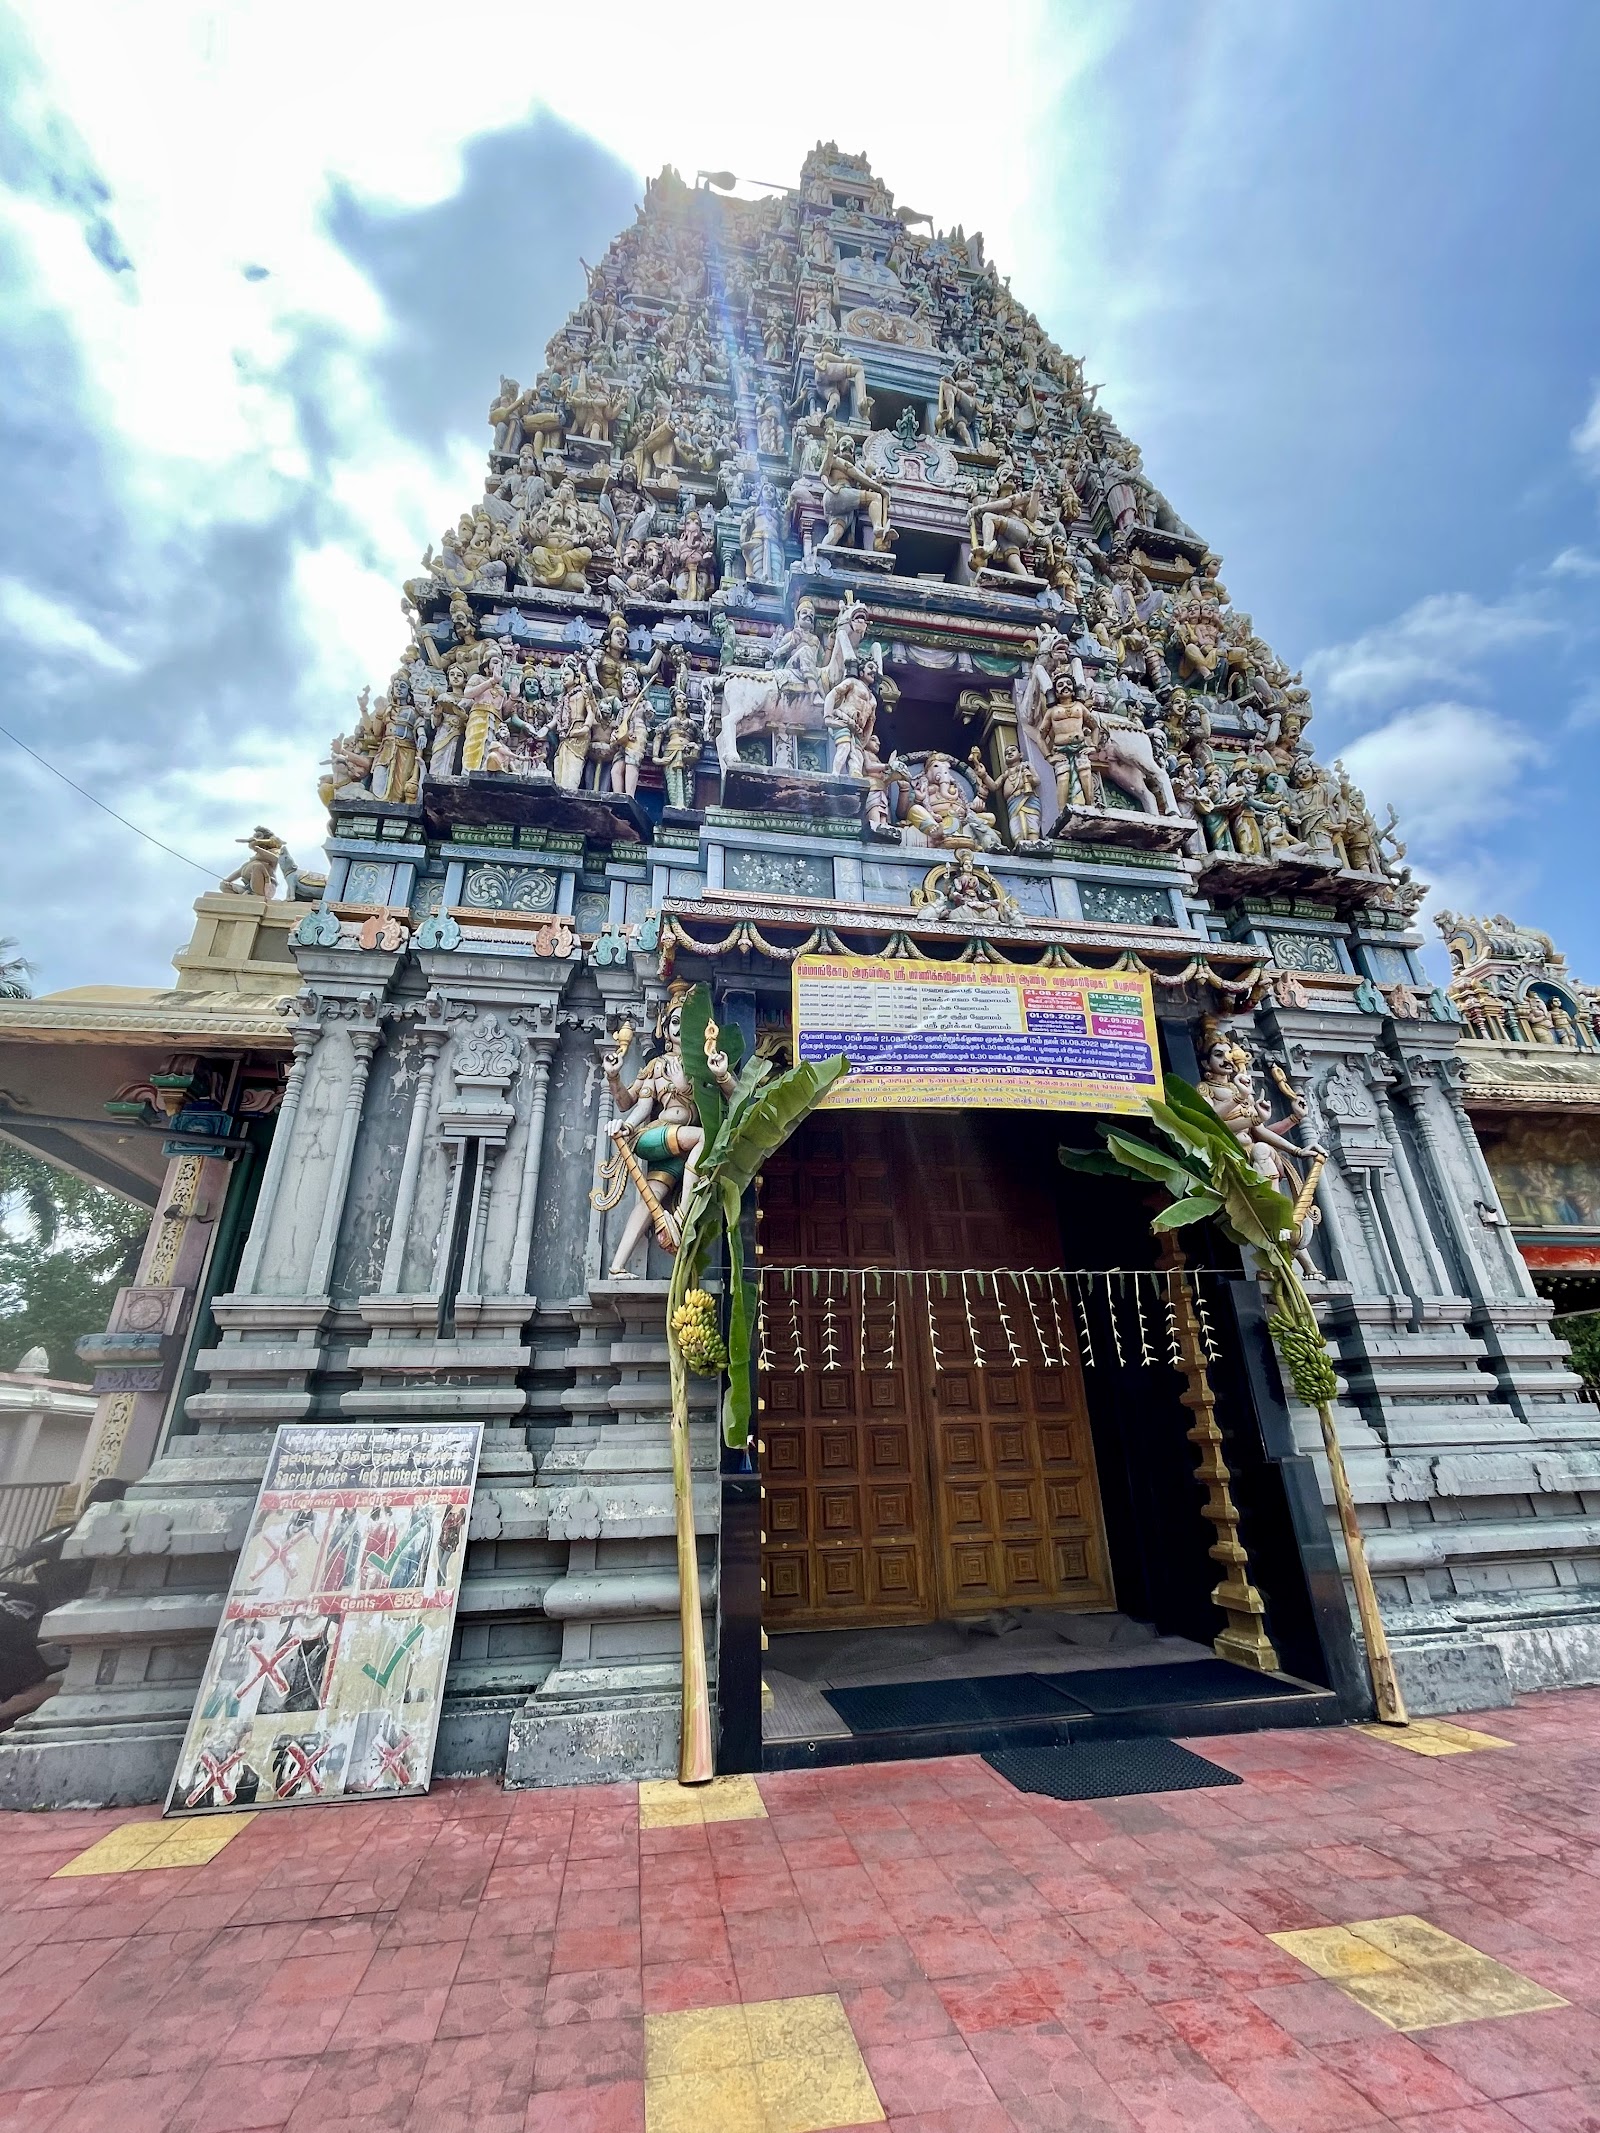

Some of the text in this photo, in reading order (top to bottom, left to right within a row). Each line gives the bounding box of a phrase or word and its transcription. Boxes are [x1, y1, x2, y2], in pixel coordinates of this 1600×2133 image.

[1089, 994, 1141, 1002] 31.08.2022
[1098, 1017, 1139, 1025] 02.09.2022
[863, 1033, 879, 1042] நாள்
[1060, 1039, 1098, 1047] 31.08.2022
[845, 1053, 866, 1061] ணிக்கு
[954, 1066, 1053, 1075] வருஷாபிஷேகப்
[1056, 1070, 1136, 1080] பெருவிழாவும்
[275, 1469, 314, 1484] Sacred
[316, 1469, 348, 1484] place
[382, 1468, 421, 1485] protect
[425, 1467, 467, 1482] sanctity
[355, 1494, 393, 1506] Ladies
[340, 1598, 376, 1610] Gents
